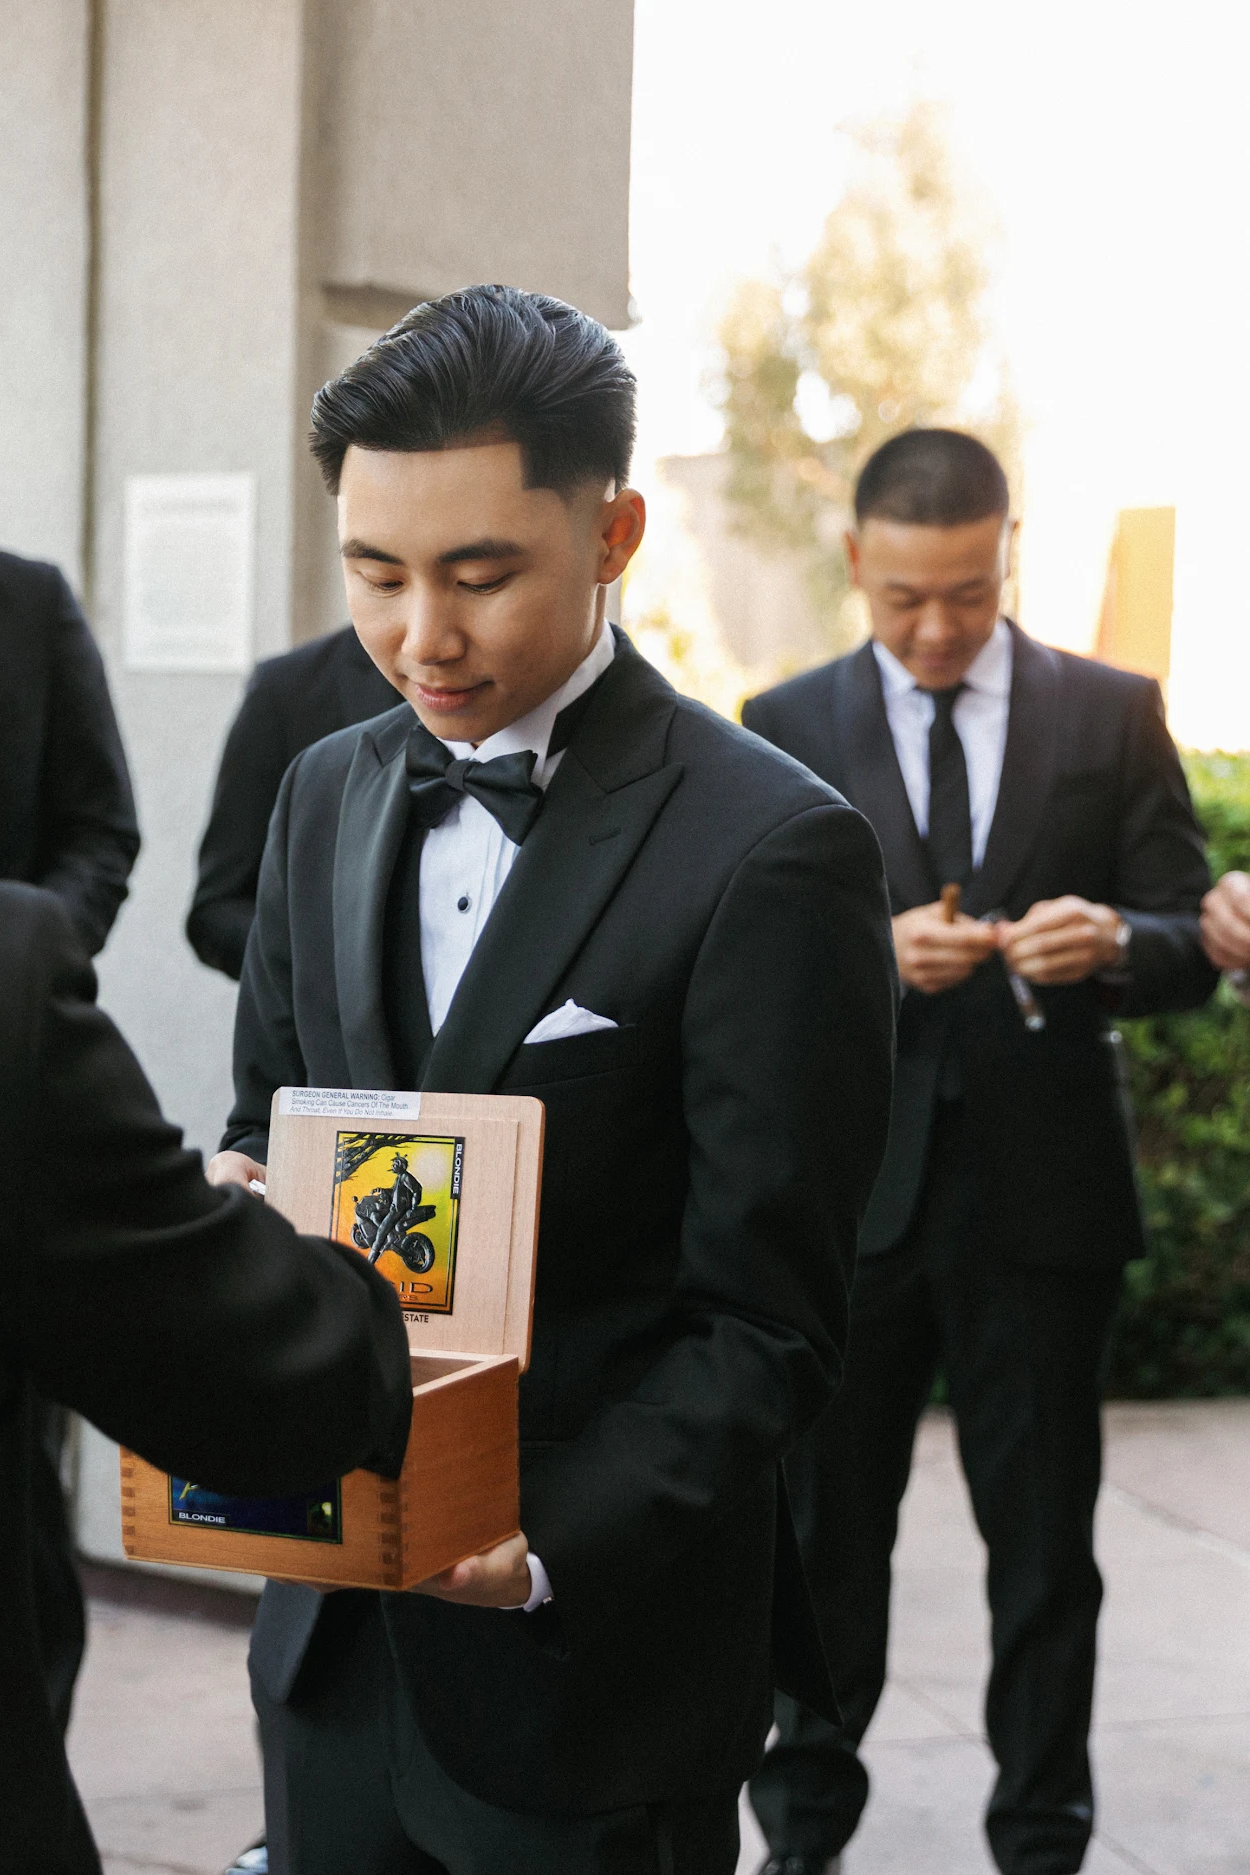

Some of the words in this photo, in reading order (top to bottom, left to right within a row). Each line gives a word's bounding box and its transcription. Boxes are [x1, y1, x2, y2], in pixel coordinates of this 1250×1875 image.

[292, 1090, 320, 1098] SURGEON
[322, 1091, 349, 1099] GENERAL
[381, 1094, 395, 1102] Cigar
[292, 1098, 314, 1106] Smoking
[347, 1100, 369, 1108] Cancers
[453, 1143, 463, 1195] BLONDIE
[178, 1511, 226, 1524] BLONDIE
